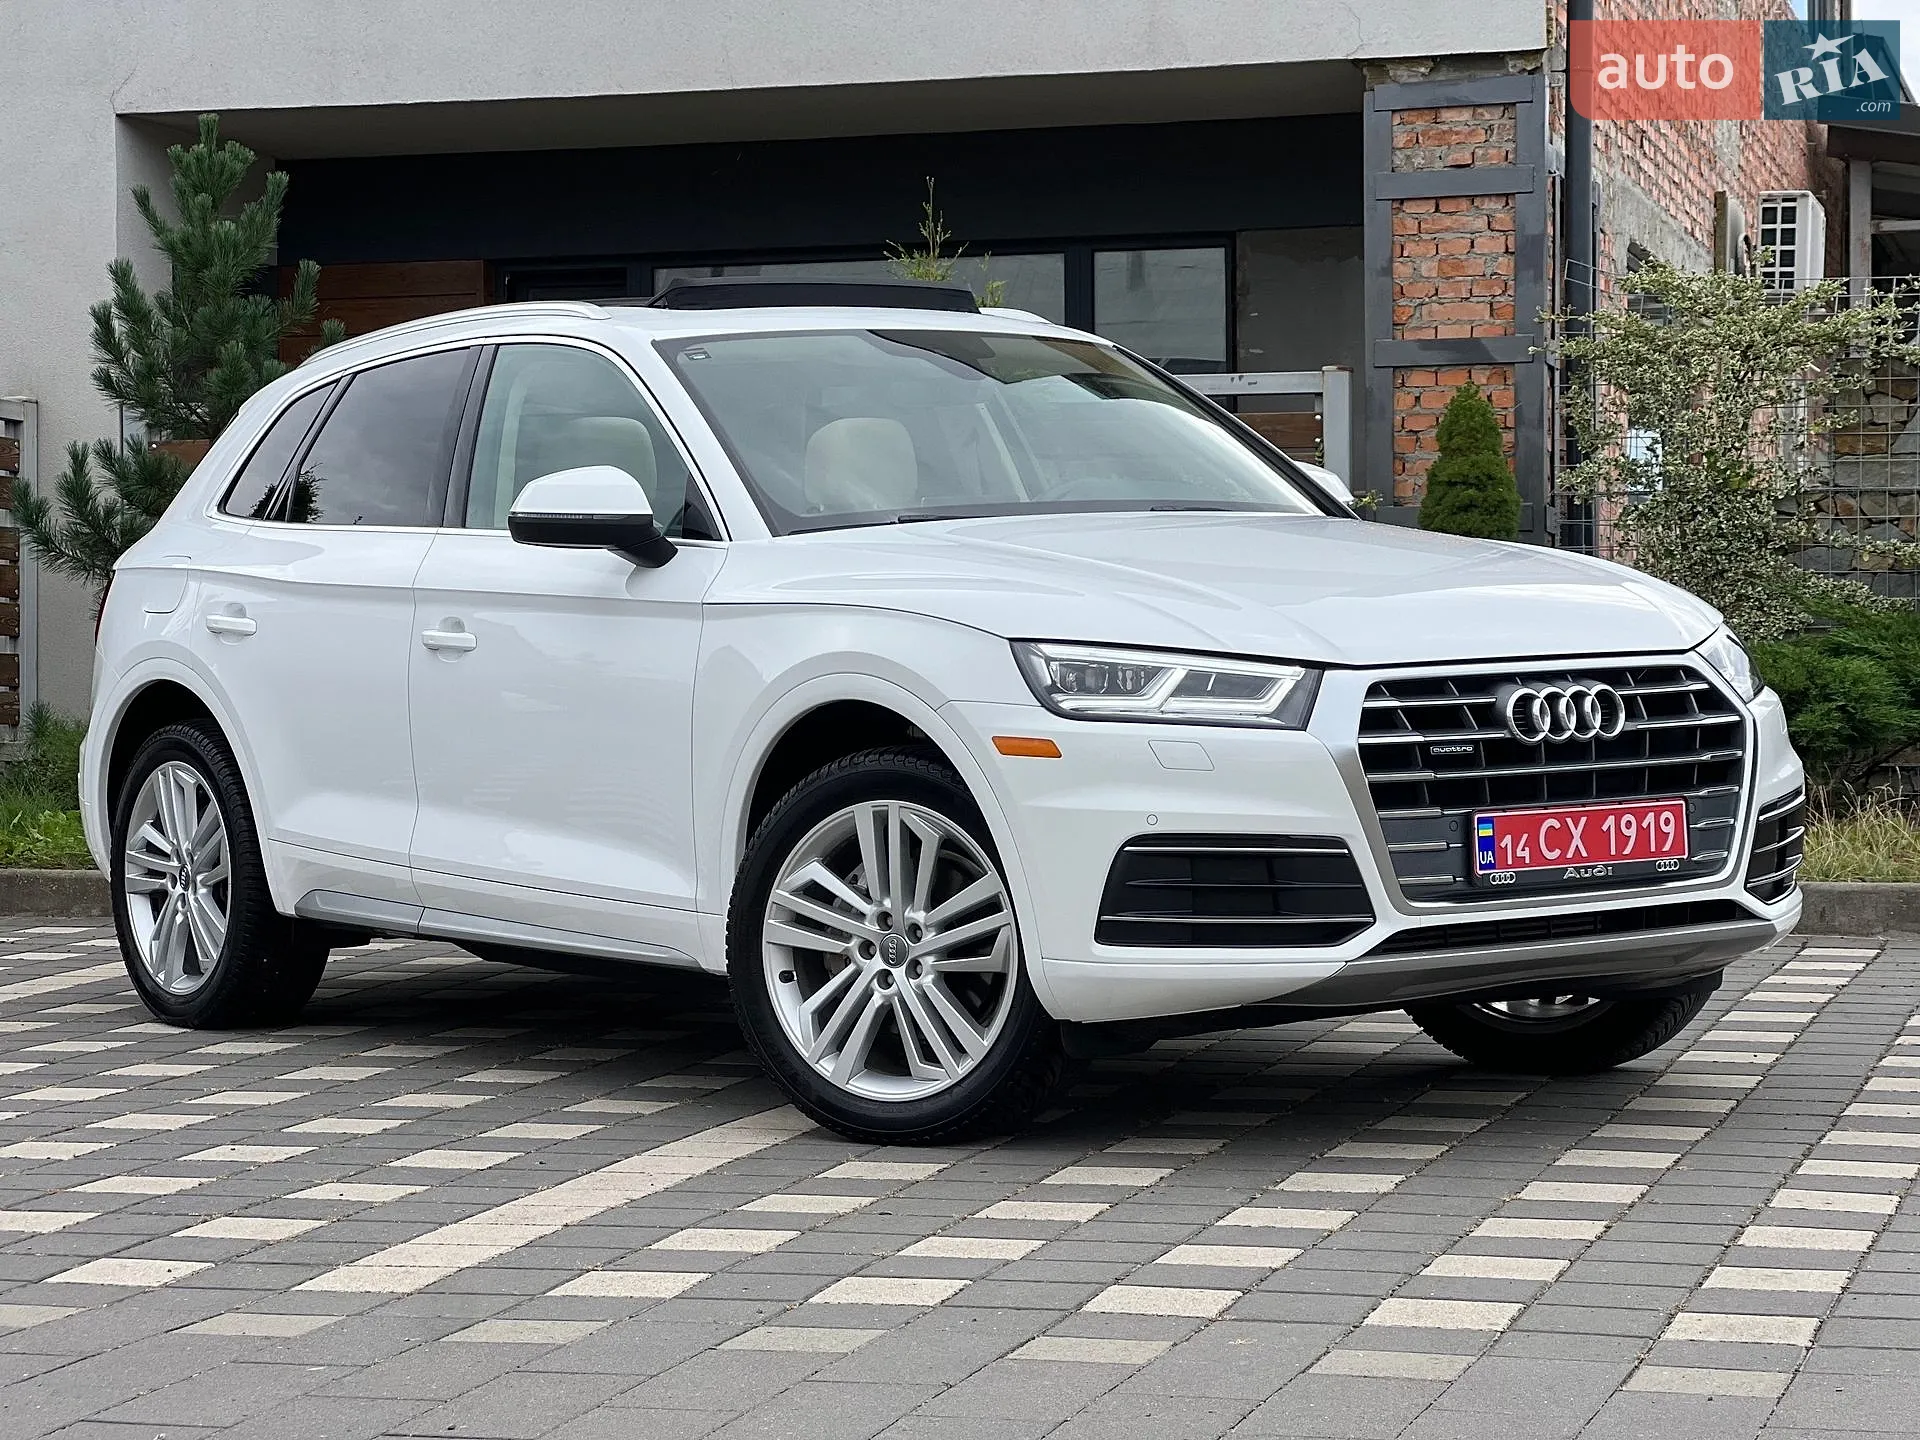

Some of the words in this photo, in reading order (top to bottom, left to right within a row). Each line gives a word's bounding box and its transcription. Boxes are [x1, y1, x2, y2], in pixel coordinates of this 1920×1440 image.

[1432, 745, 1474, 754] quattro
[1499, 833, 1531, 865] 14
[1538, 816, 1589, 860] CX
[1600, 810, 1676, 856] 1919
[1479, 851, 1495, 865] UA
[1562, 864, 1613, 880] Audi
